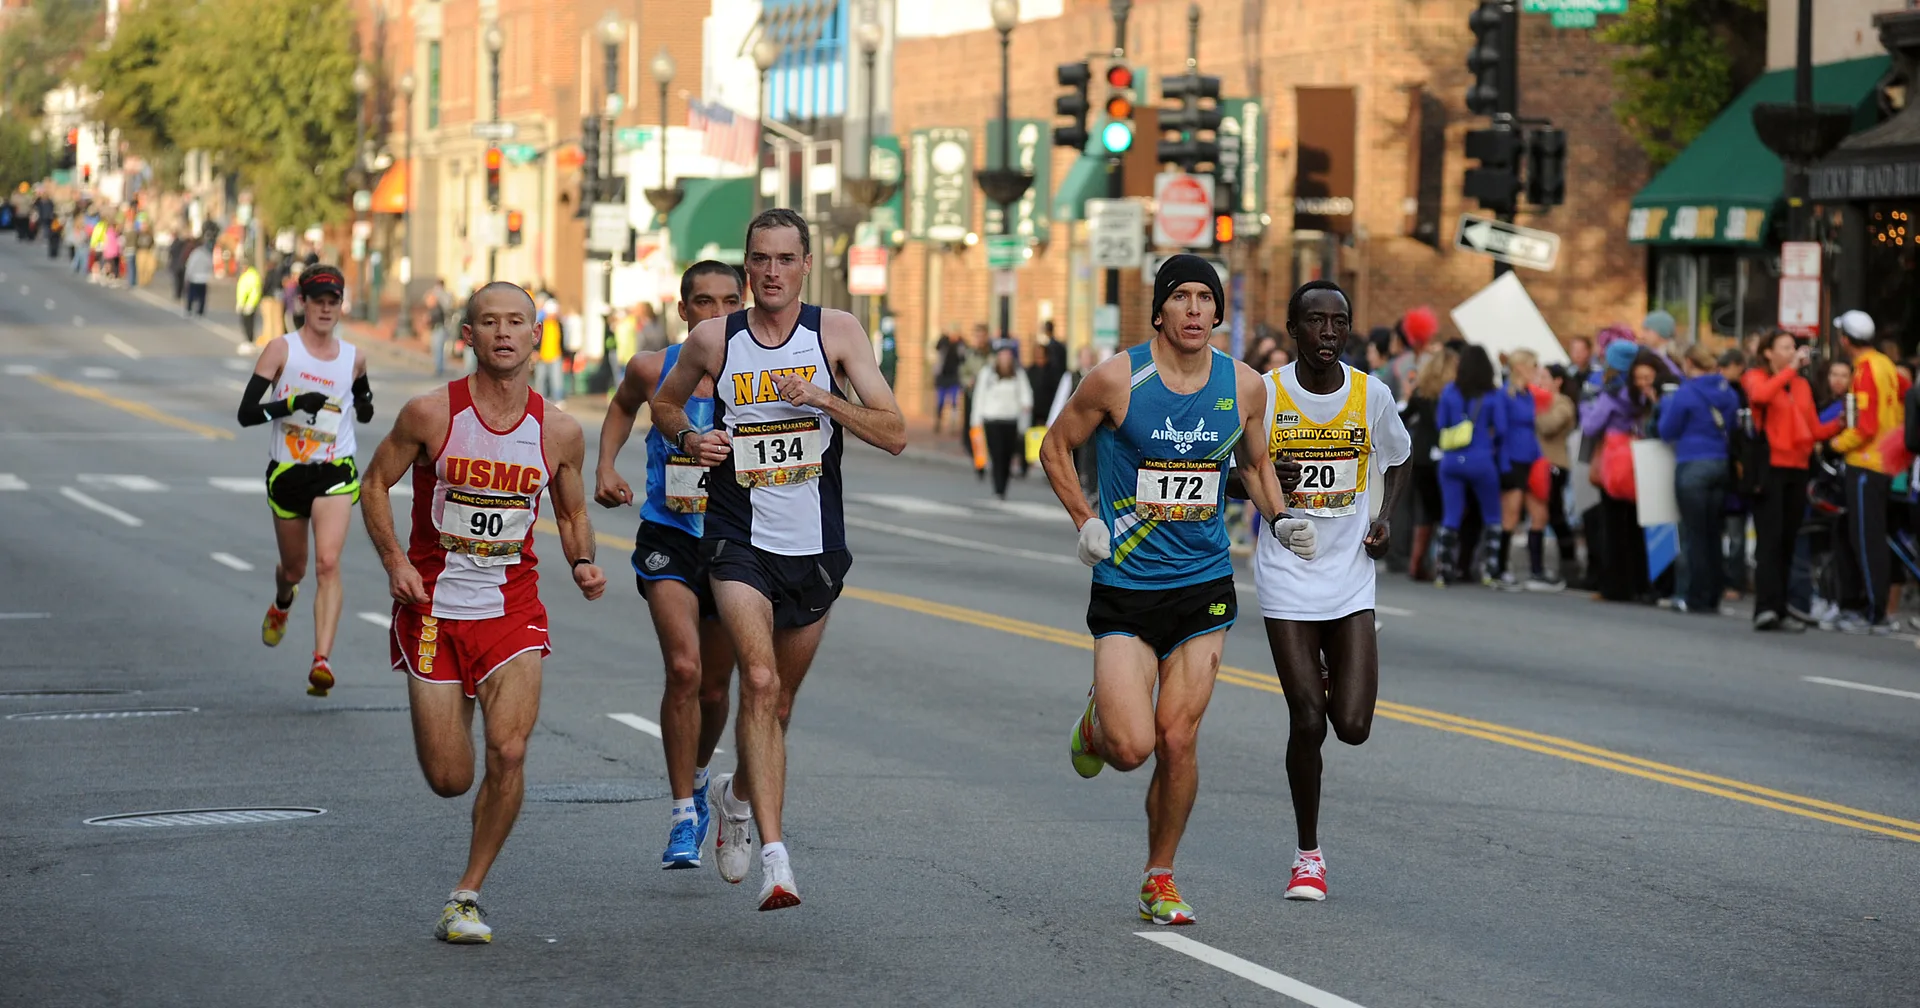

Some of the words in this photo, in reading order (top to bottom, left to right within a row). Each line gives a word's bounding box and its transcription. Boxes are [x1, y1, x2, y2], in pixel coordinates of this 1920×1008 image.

[738, 425, 761, 434] MARINE
[761, 423, 782, 432] CORPS
[782, 420, 815, 430] MARATHON
[1151, 429, 1175, 441] AIR
[1177, 431, 1219, 441] FORCE
[1275, 428, 1351, 442] goarmy.com
[753, 436, 804, 465] 134
[1324, 450, 1355, 458] MARATHON
[671, 455, 691, 463] MARINE
[1145, 460, 1168, 468] MARINE
[1168, 461, 1186, 469] CORPS
[1186, 461, 1217, 470] MARATHON
[446, 456, 542, 495] USMC
[1303, 465, 1336, 489] 20
[1157, 475, 1204, 500] 172
[452, 492, 475, 503] MARINE
[475, 496, 494, 505] CORPS
[495, 498, 525, 506] MARATHON
[470, 511, 504, 537] 90
[417, 614, 438, 674] USMC
